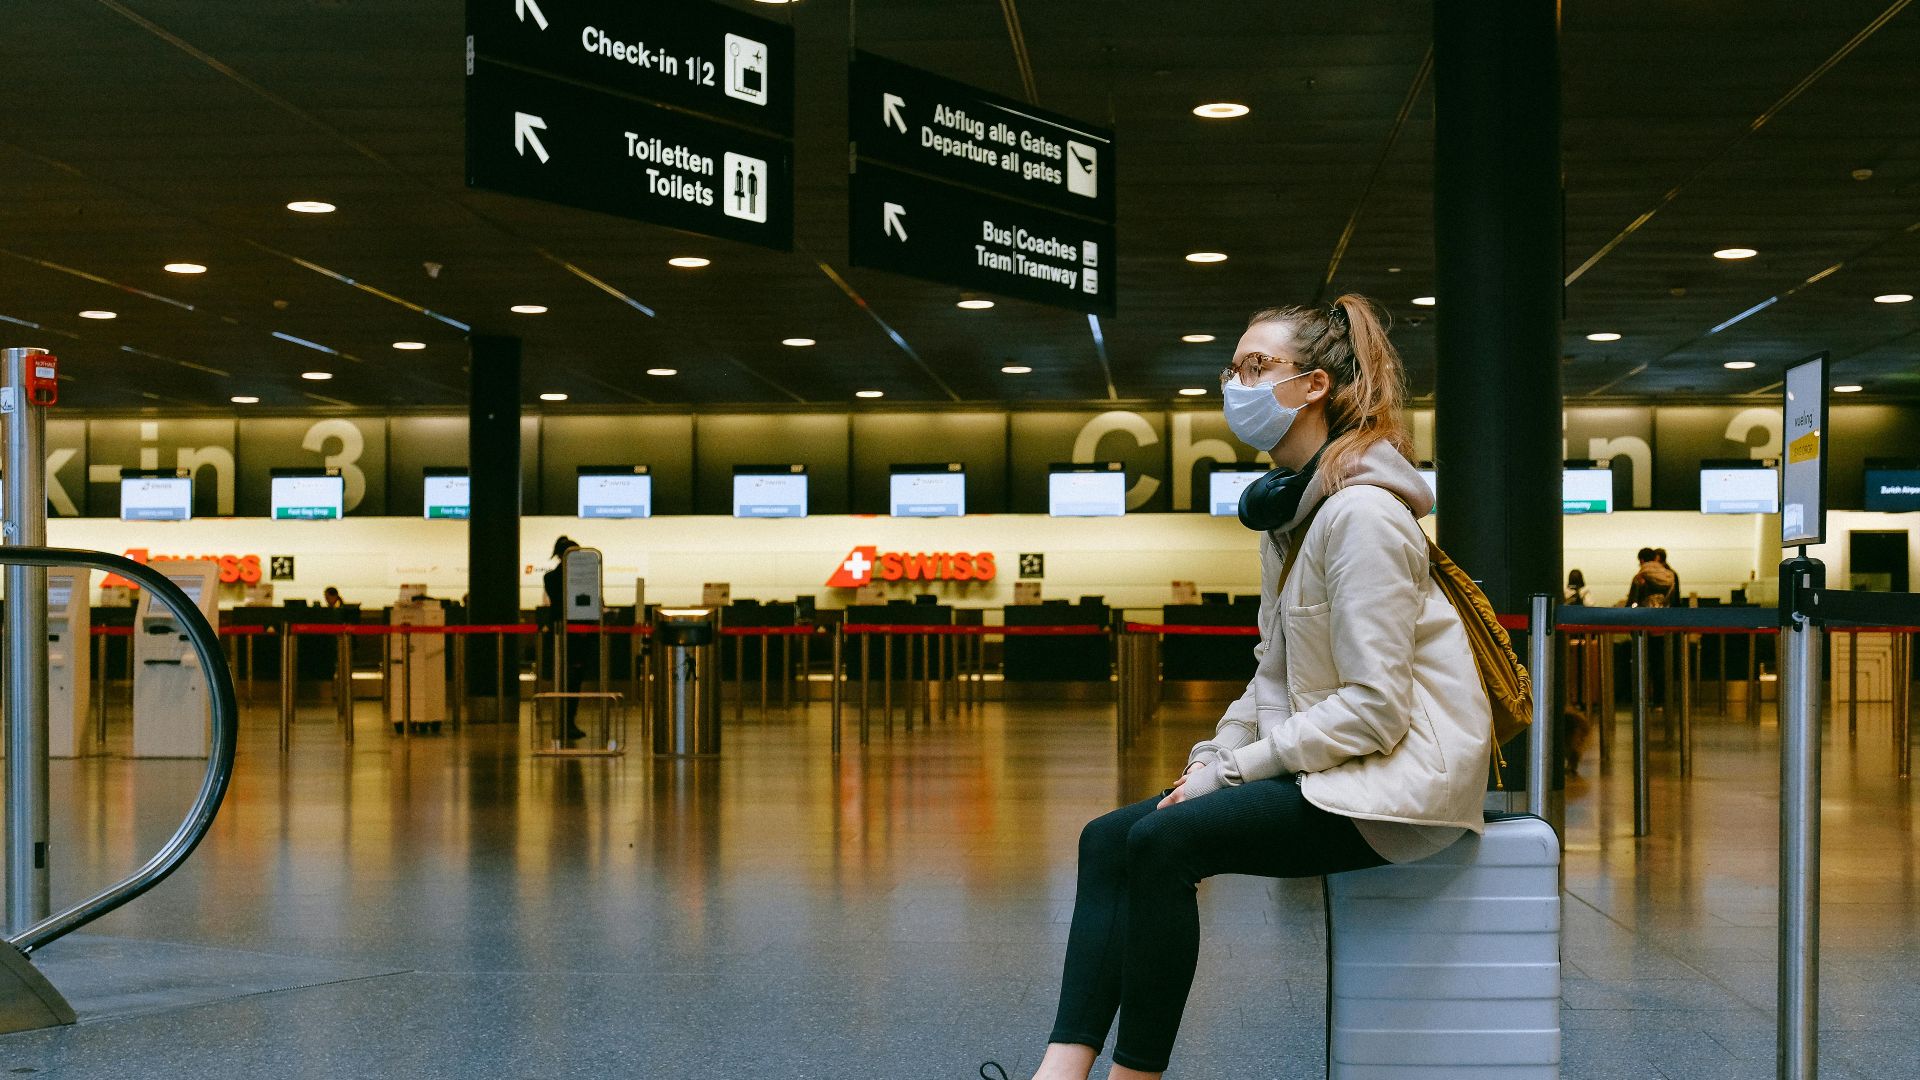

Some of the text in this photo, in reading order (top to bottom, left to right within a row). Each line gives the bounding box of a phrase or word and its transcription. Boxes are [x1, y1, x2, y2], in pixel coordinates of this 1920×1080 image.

[582, 26, 678, 75] Check-in
[625, 132, 714, 176] Toiletten
[921, 126, 1062, 184] Departure all gates
[934, 104, 1062, 160] Abflug alle Gates
[646, 169, 714, 206] Toilets
[880, 552, 996, 581] SWISS
